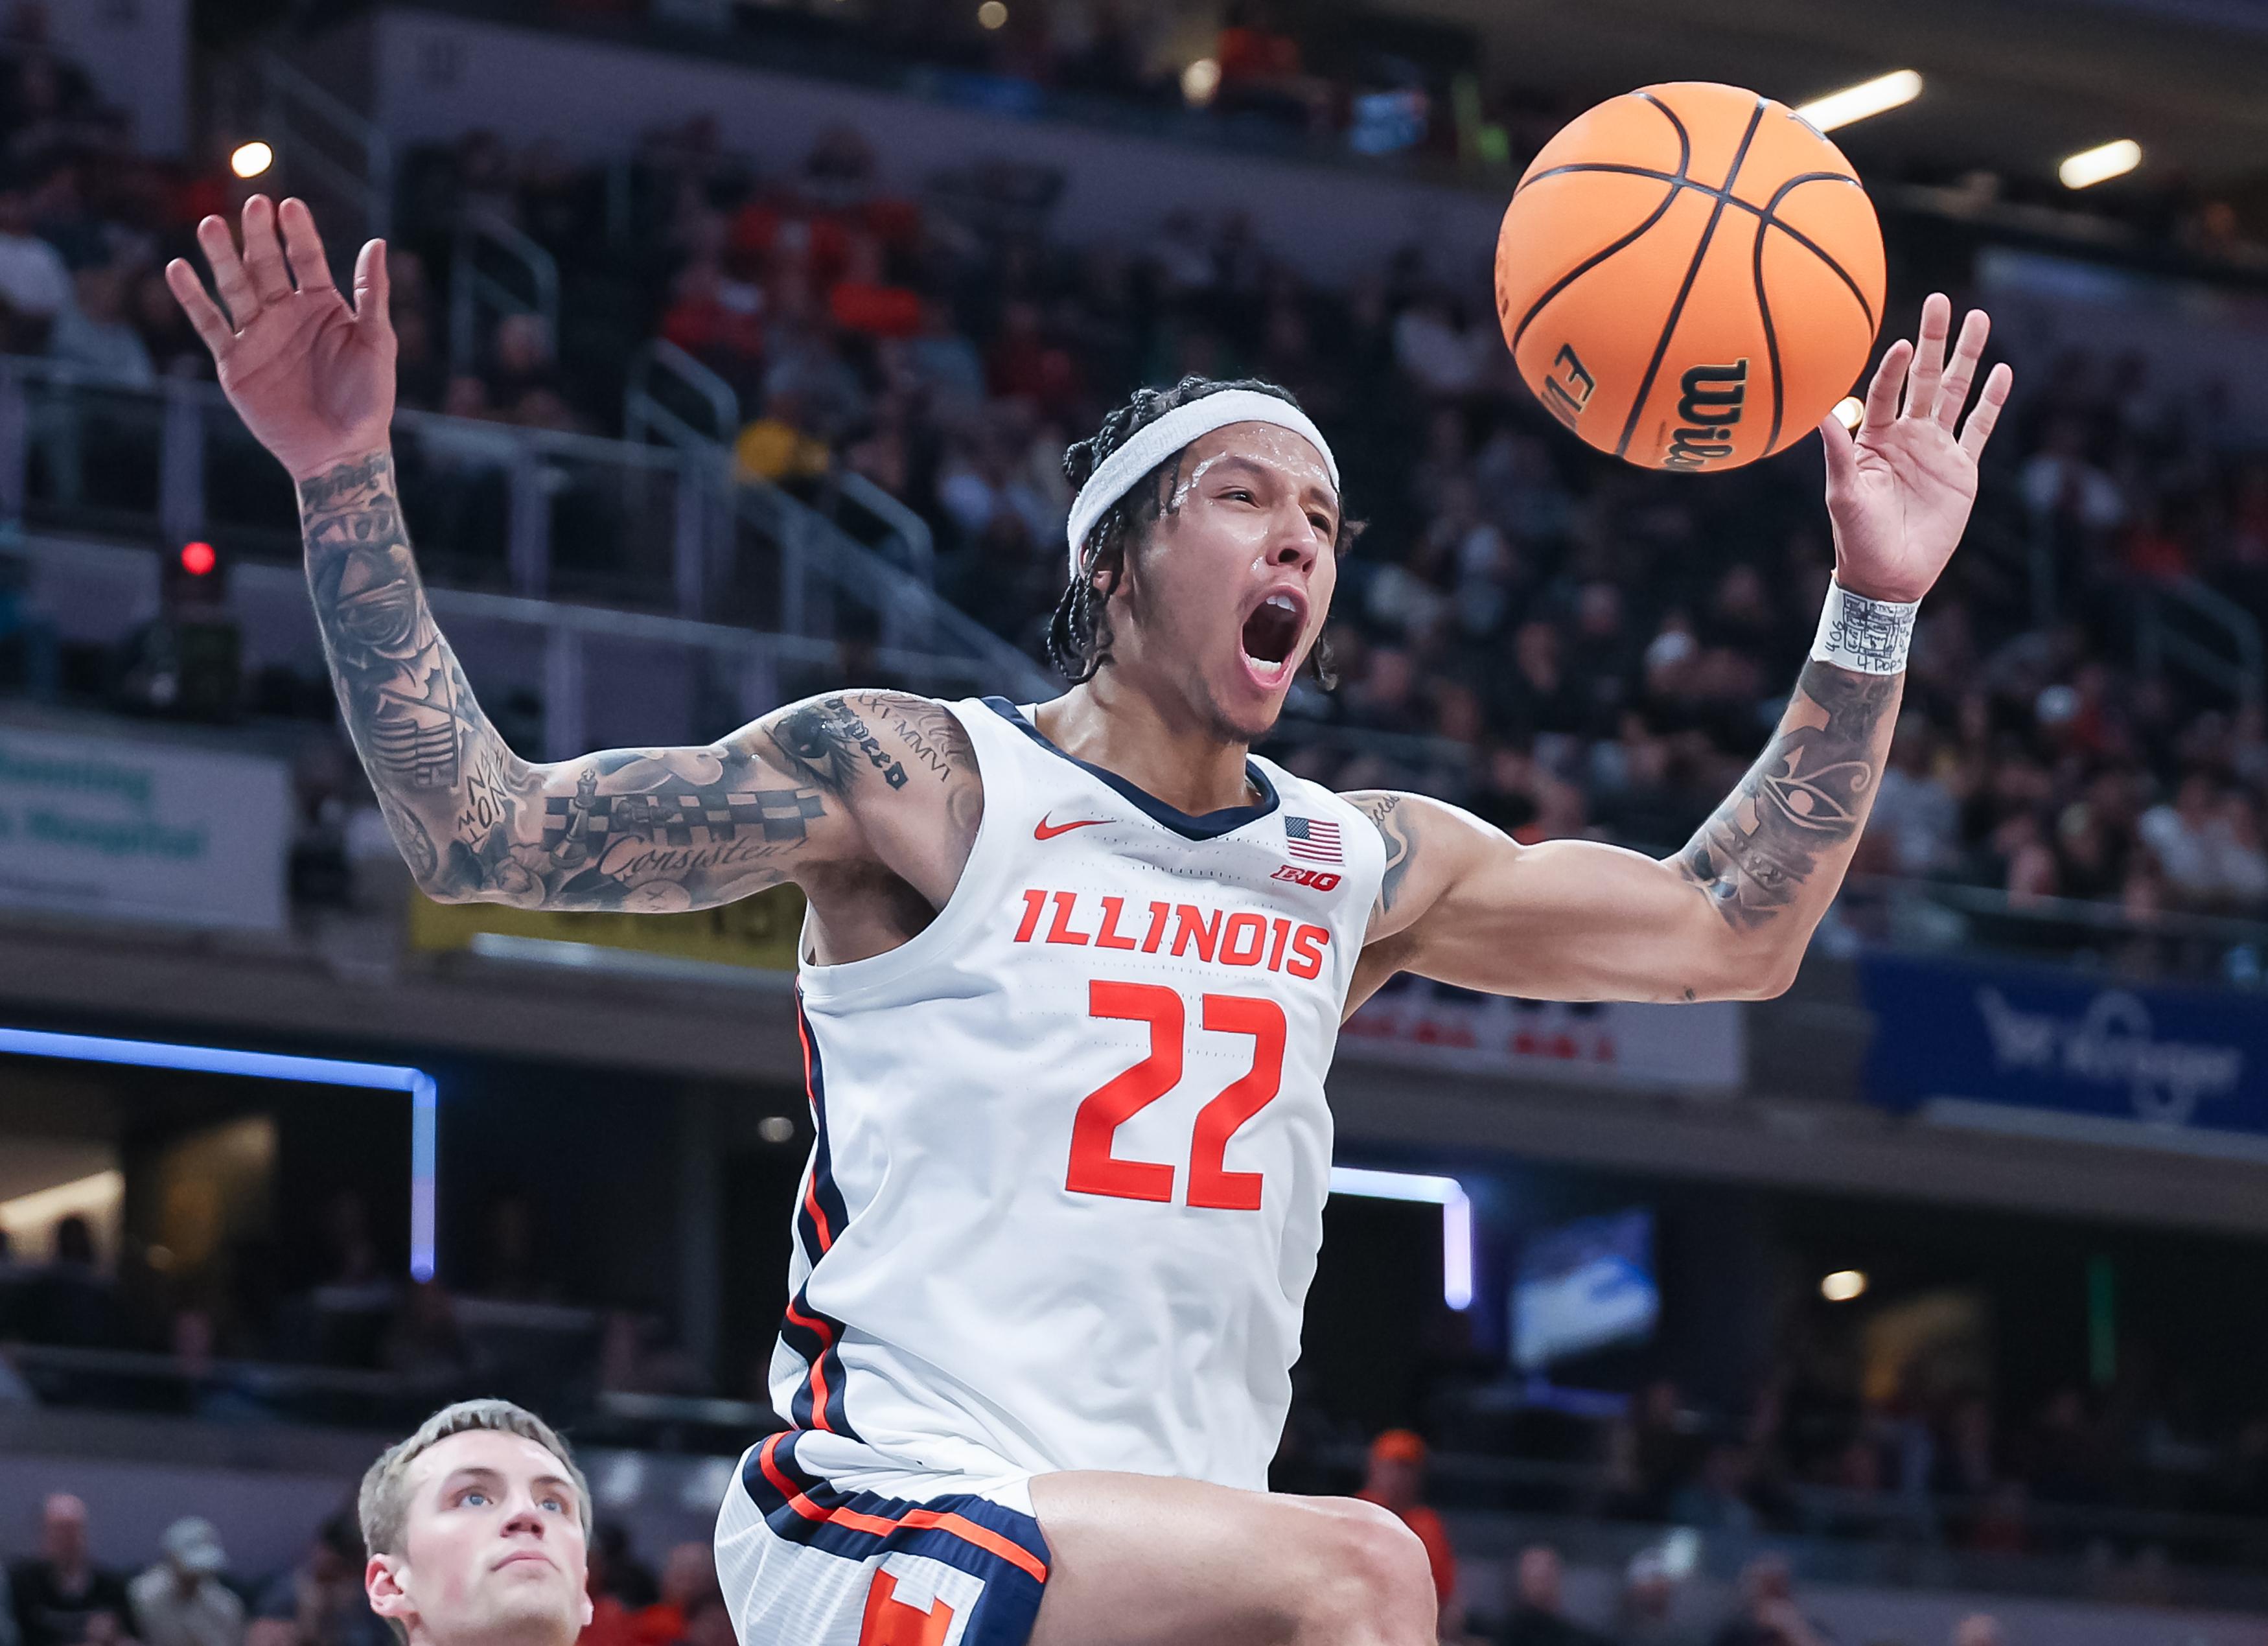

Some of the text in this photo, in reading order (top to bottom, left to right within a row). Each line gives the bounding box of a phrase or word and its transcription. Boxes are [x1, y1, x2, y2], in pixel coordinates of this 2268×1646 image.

[1541, 343, 1595, 431] EV
[1660, 357, 1749, 471] Wil
[1013, 890, 1330, 980] ILLINOIS
[1065, 979, 1287, 1211] 22
